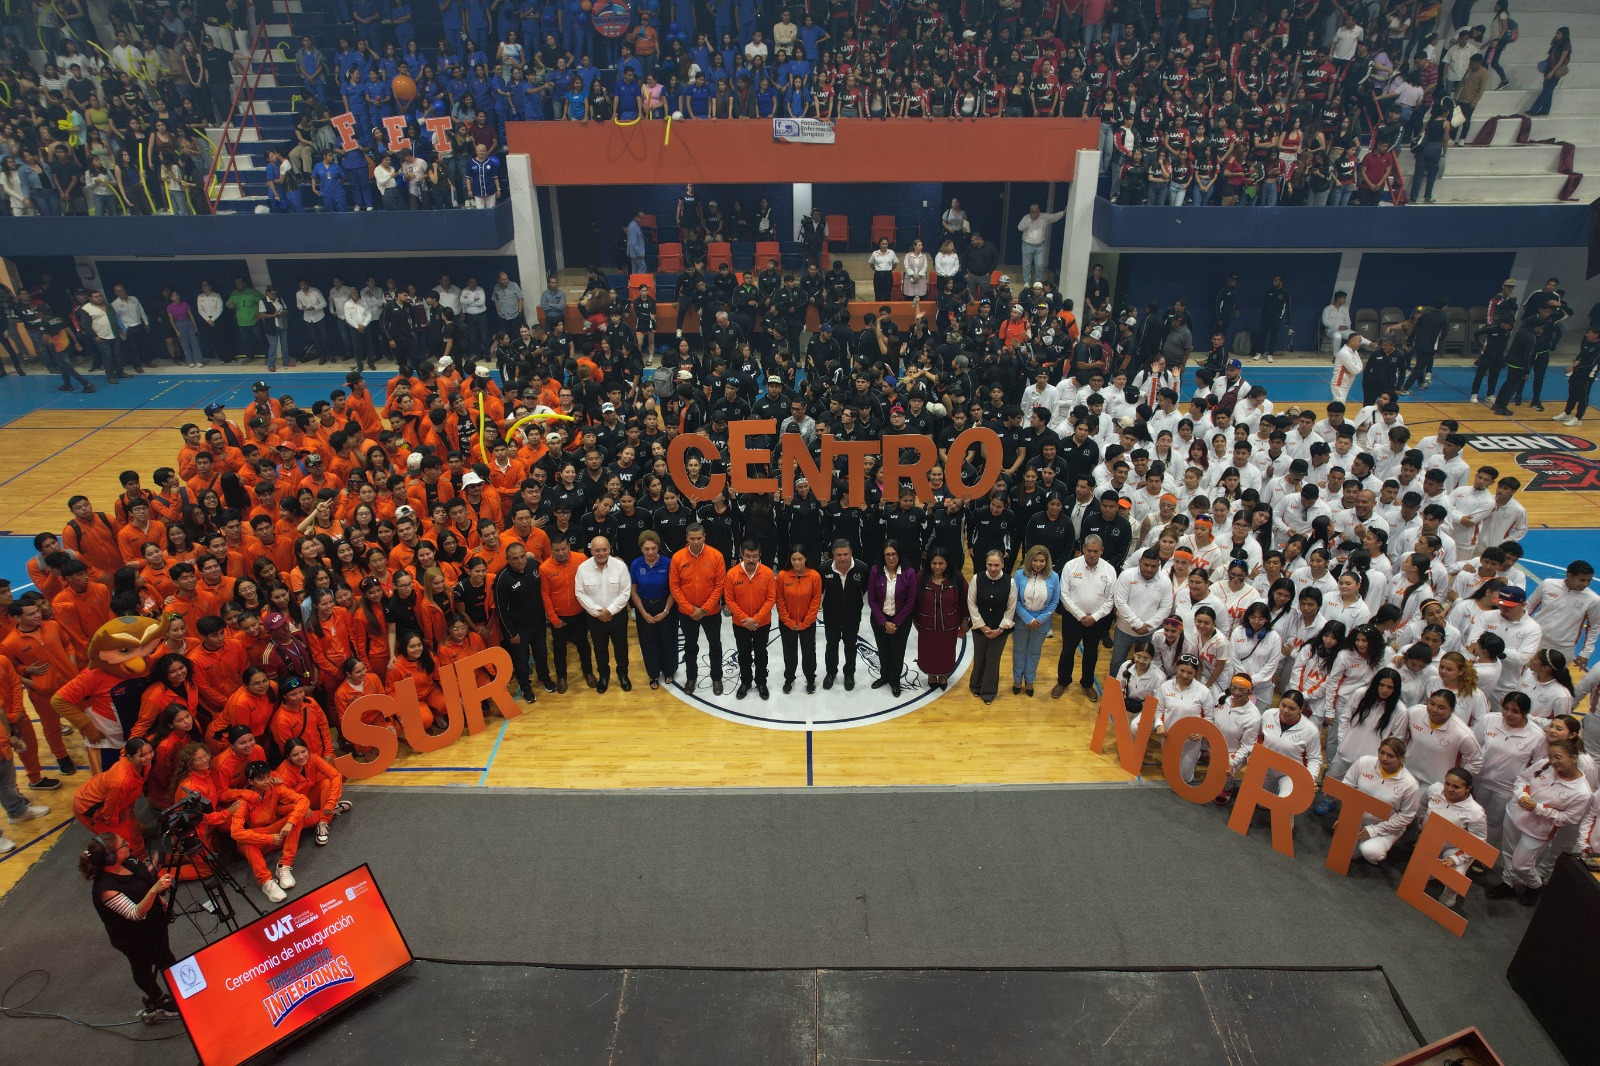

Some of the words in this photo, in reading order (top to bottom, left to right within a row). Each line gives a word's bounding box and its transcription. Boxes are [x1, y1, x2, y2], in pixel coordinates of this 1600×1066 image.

[1306, 70, 1328, 78] UAT
[331, 111, 453, 153] FET
[667, 418, 1004, 508] CENTRO
[271, 614, 284, 623] UAT
[334, 646, 524, 780] SUR
[1412, 723, 1424, 732] UAT
[1089, 674, 1501, 939] NORTE
[225, 954, 280, 991] Ceremonia
[280, 946, 294, 962] de
[293, 914, 355, 954] Inauguración
[264, 914, 294, 942] UAT
[262, 955, 354, 1024] INTERZONAS
